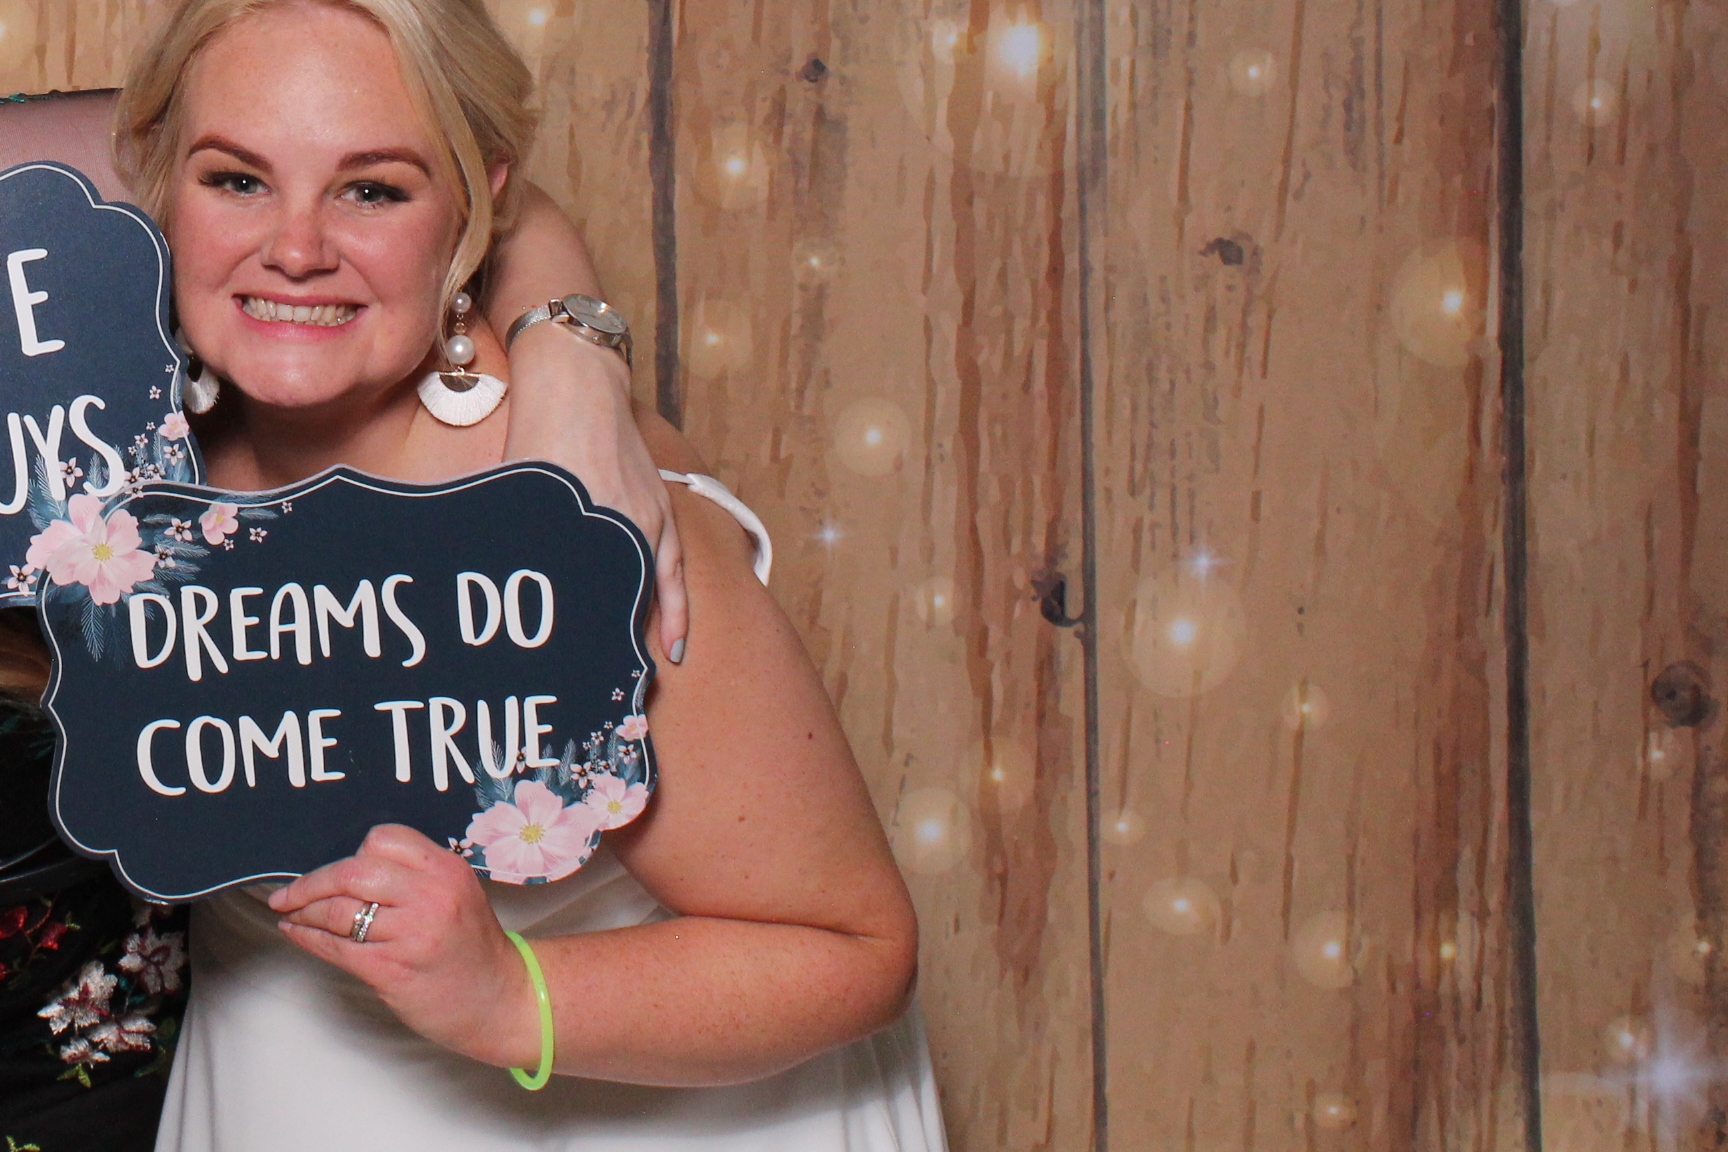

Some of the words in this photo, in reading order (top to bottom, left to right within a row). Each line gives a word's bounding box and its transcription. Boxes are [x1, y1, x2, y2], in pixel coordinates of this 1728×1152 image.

[128, 573, 427, 681] DREAMS
[456, 569, 555, 648] DO
[136, 708, 346, 796] COME
[373, 695, 560, 792] TRUE
